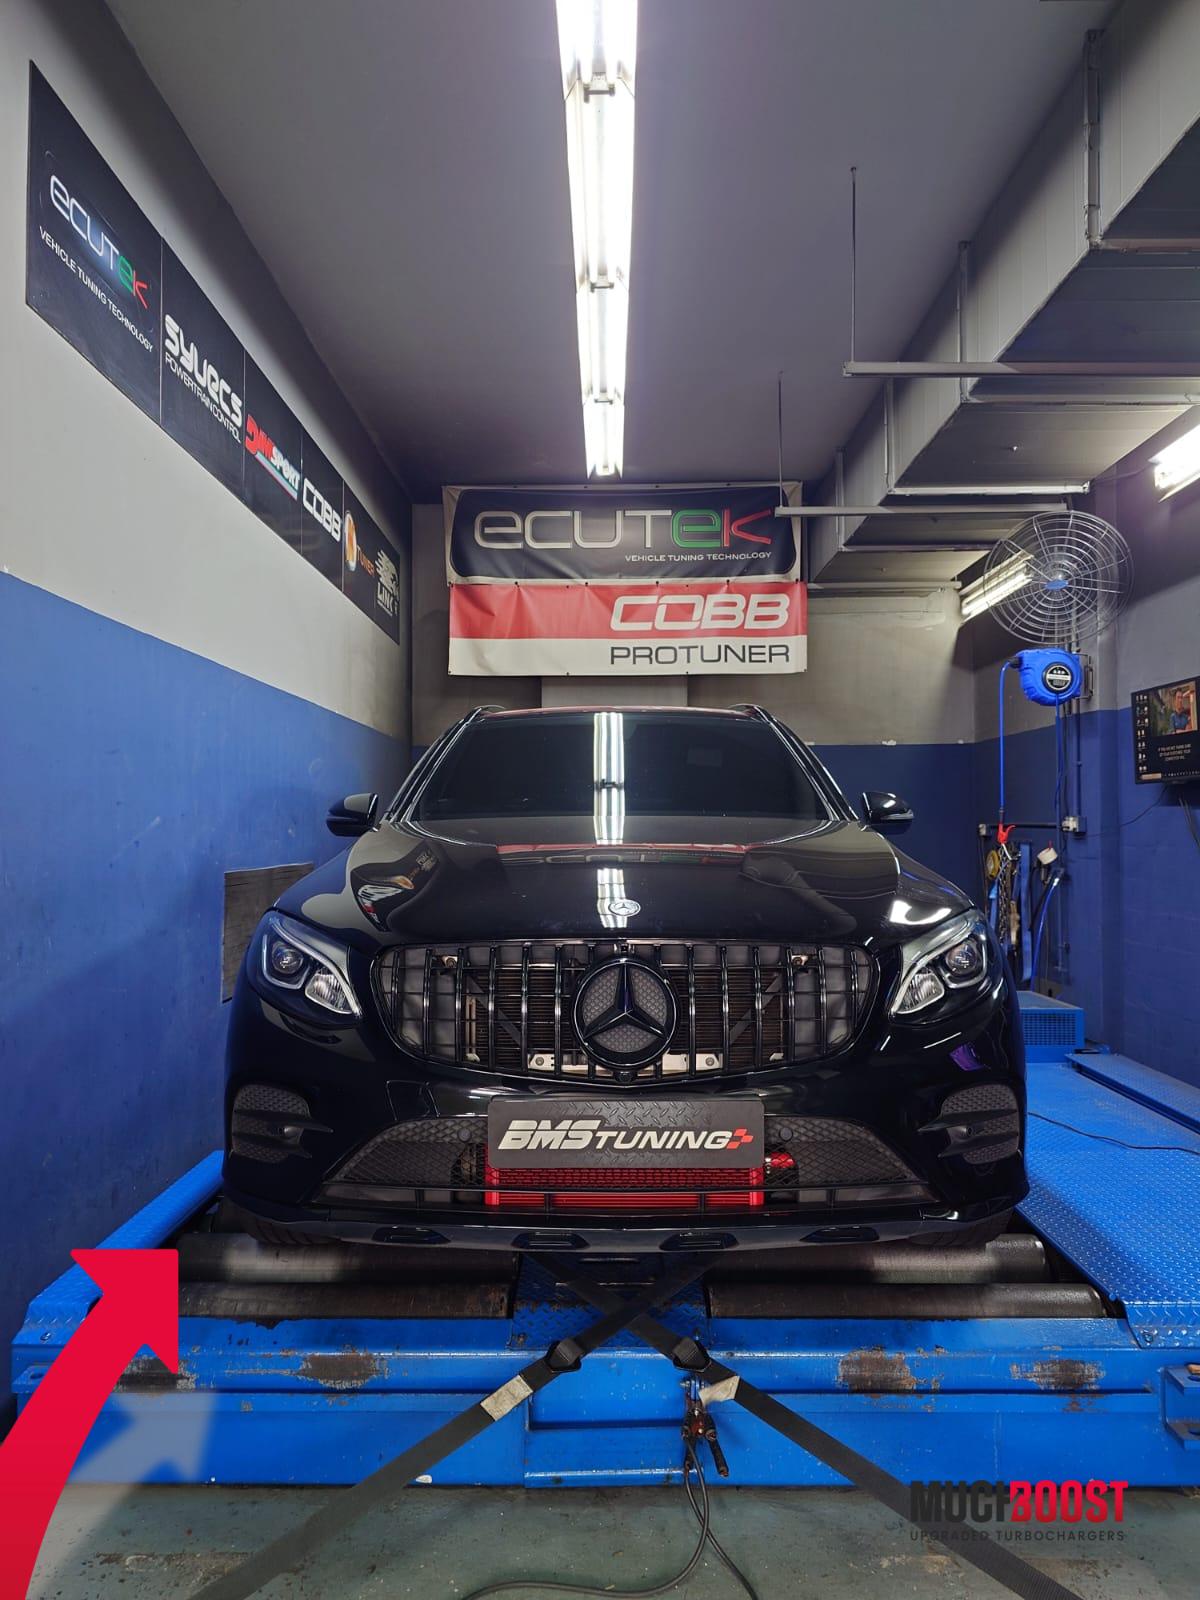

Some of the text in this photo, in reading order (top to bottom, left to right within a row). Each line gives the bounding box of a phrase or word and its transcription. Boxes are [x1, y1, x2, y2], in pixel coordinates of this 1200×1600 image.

[39, 225, 153, 352] VEHICLE TUNING TECHNOLOGY
[303, 478, 341, 542] COBB
[625, 554, 666, 562] VEHICLE
[706, 551, 772, 561] TECHNOLOGY
[610, 593, 790, 631] COBB
[610, 644, 790, 665] PROTUNER
